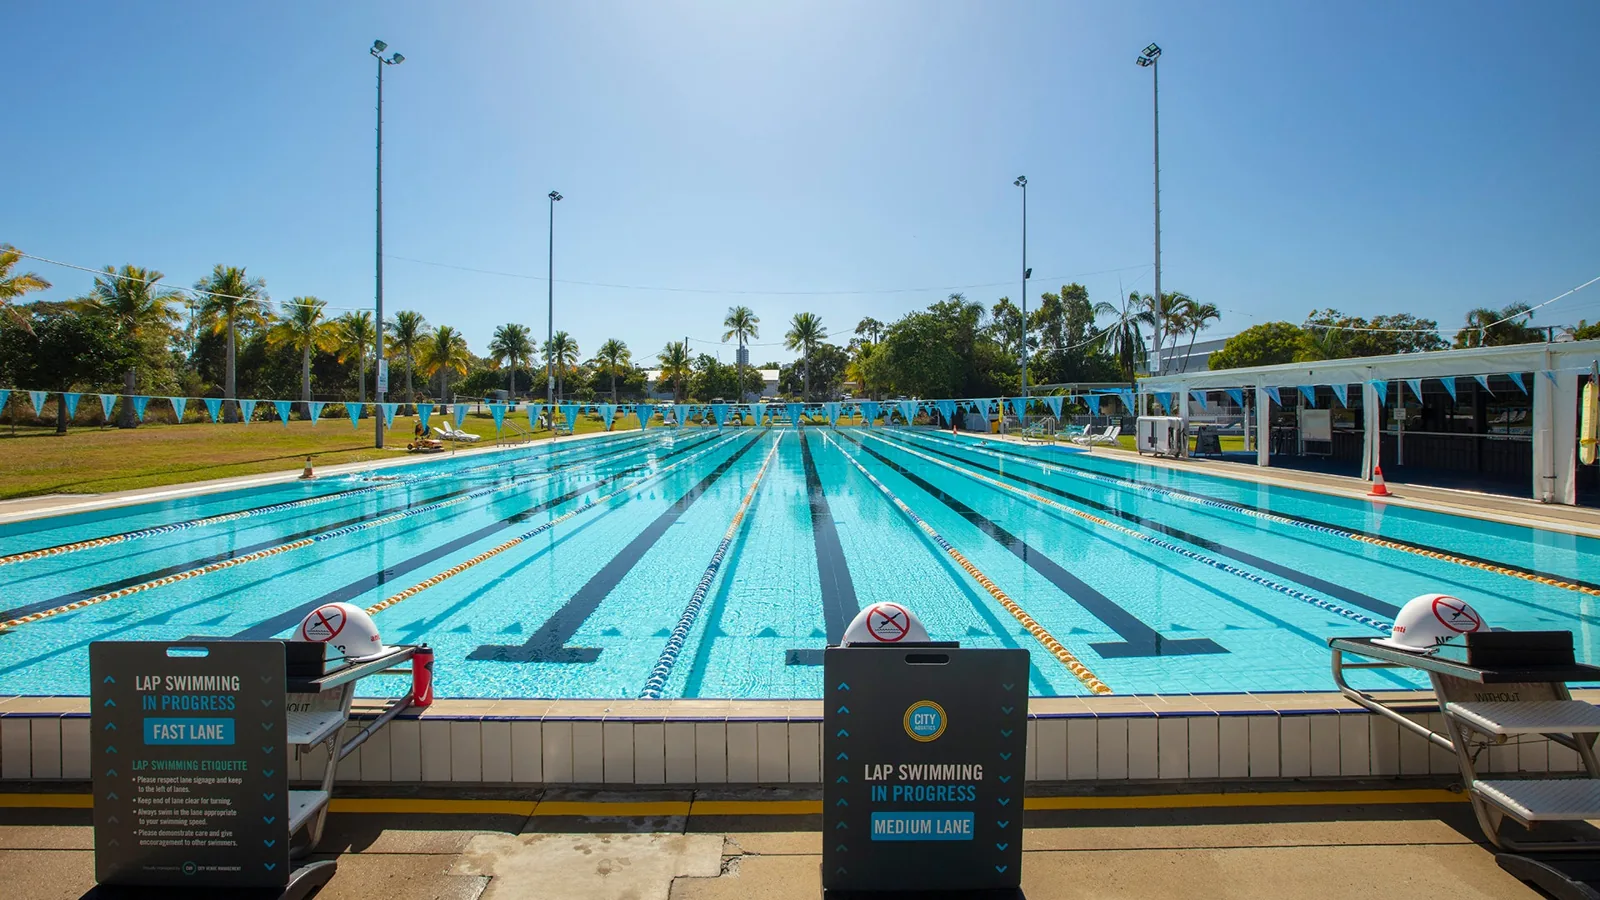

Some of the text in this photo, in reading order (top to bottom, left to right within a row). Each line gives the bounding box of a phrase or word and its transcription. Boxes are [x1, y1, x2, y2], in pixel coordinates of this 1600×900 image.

[136, 676, 240, 690] LAP SWIMMING
[143, 696, 235, 710] IN PROGRESS
[915, 714, 935, 724] CITY
[153, 725, 224, 739] FAST LANE
[132, 761, 247, 771] LAP SWIMMING ETIQUETTE
[865, 765, 983, 780] LAP SWIMMING
[157, 776, 179, 784] respect
[193, 776, 215, 784] signage
[228, 776, 242, 784] keep
[872, 786, 976, 801] IN PROGRESS
[875, 820, 970, 834] MEDIUM LANE
